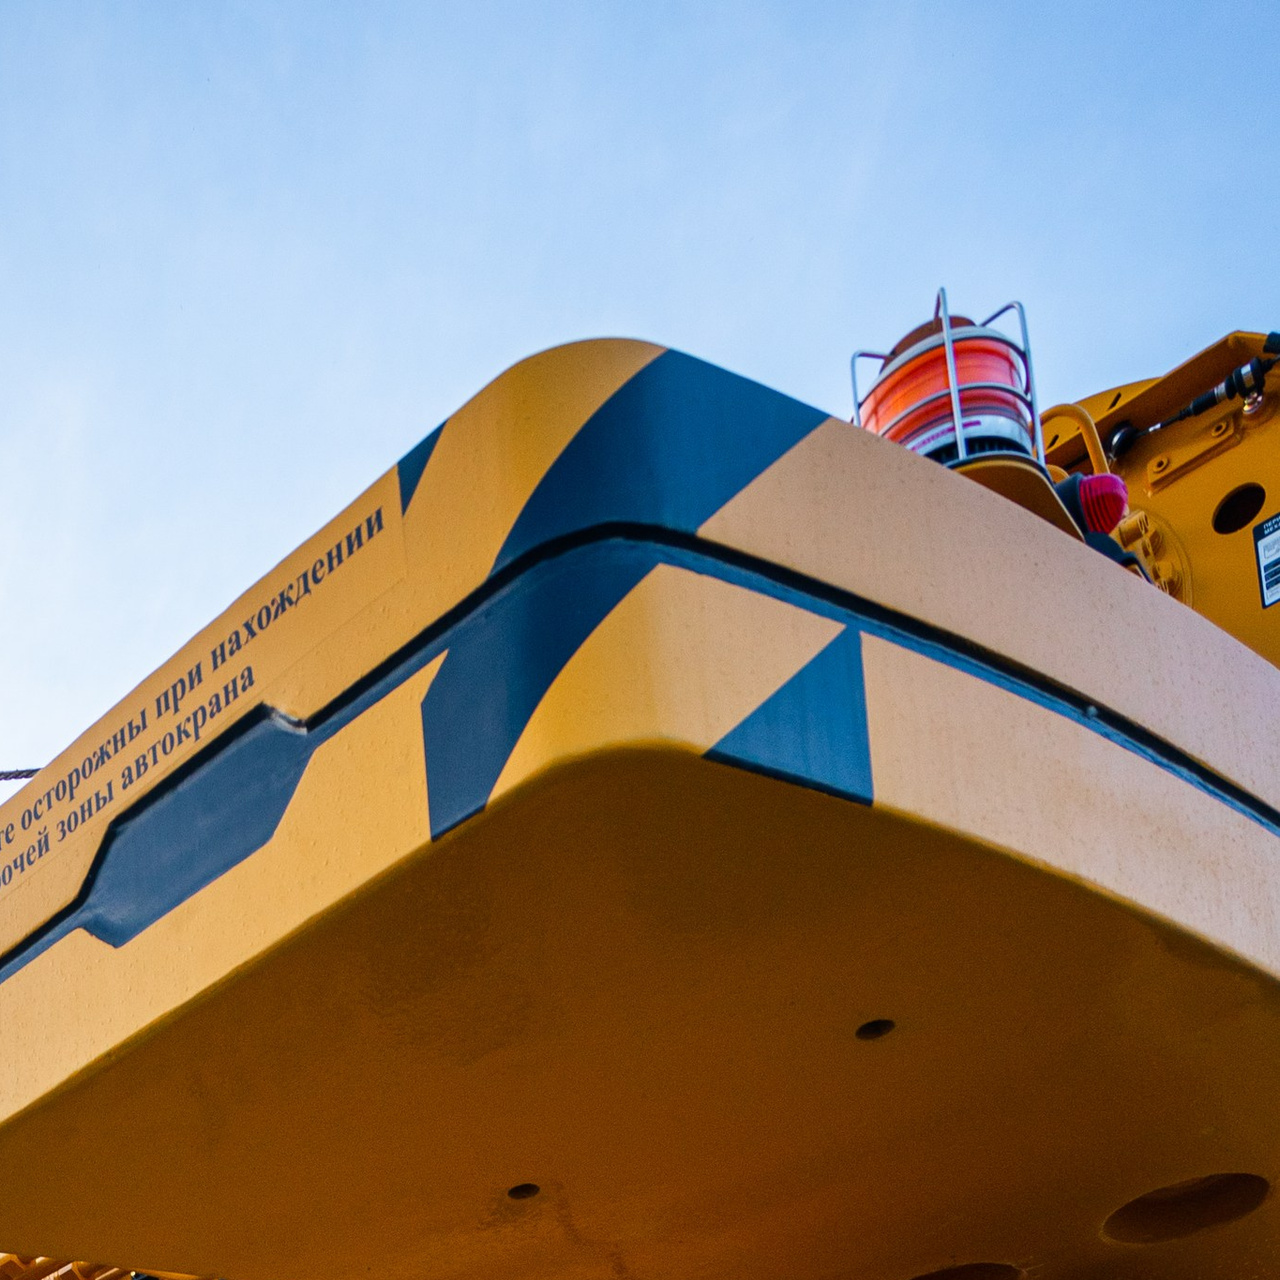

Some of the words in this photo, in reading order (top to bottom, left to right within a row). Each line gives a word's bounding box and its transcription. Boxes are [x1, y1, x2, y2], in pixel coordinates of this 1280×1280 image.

[21, 708, 147, 831] осторожны
[155, 661, 203, 720] при
[210, 505, 384, 673] нахождении
[56, 780, 114, 842] зоны
[121, 665, 254, 790] автокрана
